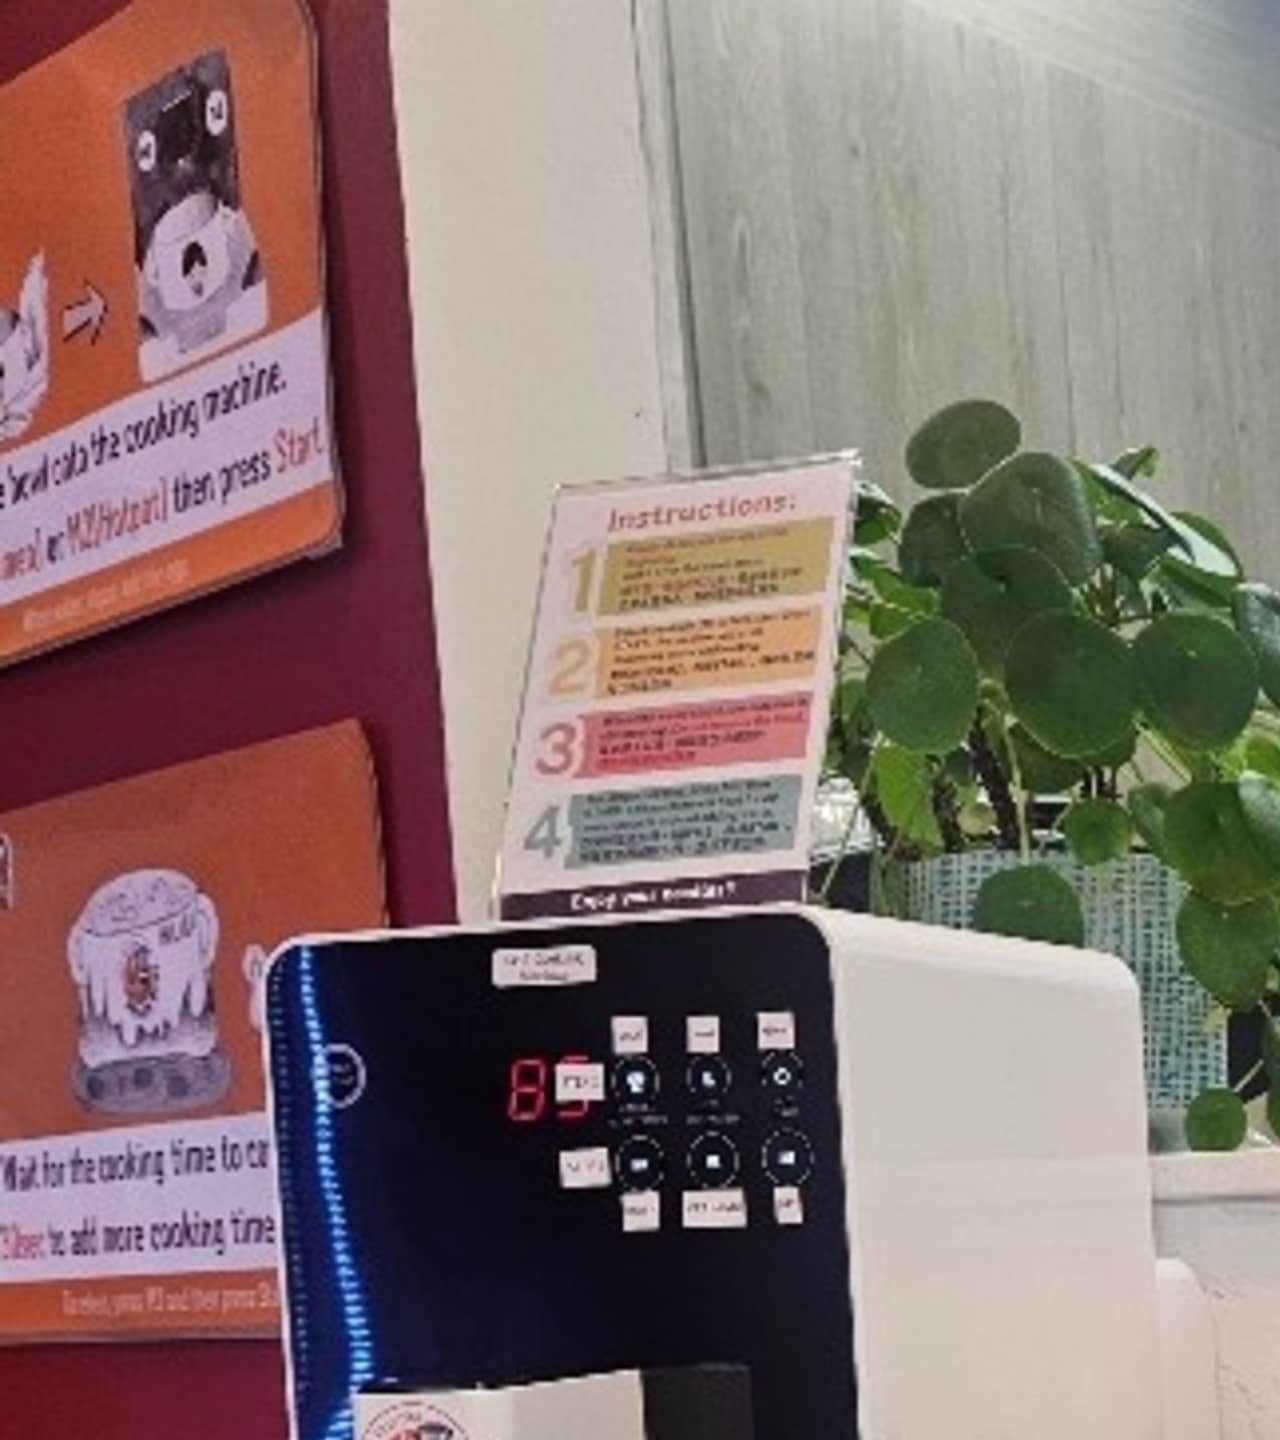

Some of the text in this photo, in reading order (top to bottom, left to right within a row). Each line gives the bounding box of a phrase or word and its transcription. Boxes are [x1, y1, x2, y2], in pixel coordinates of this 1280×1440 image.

[220, 451, 272, 506] press
[607, 494, 797, 532] Instructions:
[572, 549, 596, 611] 1
[549, 641, 590, 696] 2
[534, 723, 577, 776] 3
[523, 806, 560, 858] 4
[99, 1141, 164, 1185] cooking
[171, 1138, 215, 1176] time
[222, 1135, 243, 1172] to
[103, 1225, 144, 1253] more
[151, 1208, 223, 1255] cooking
[230, 1209, 275, 1245] time
